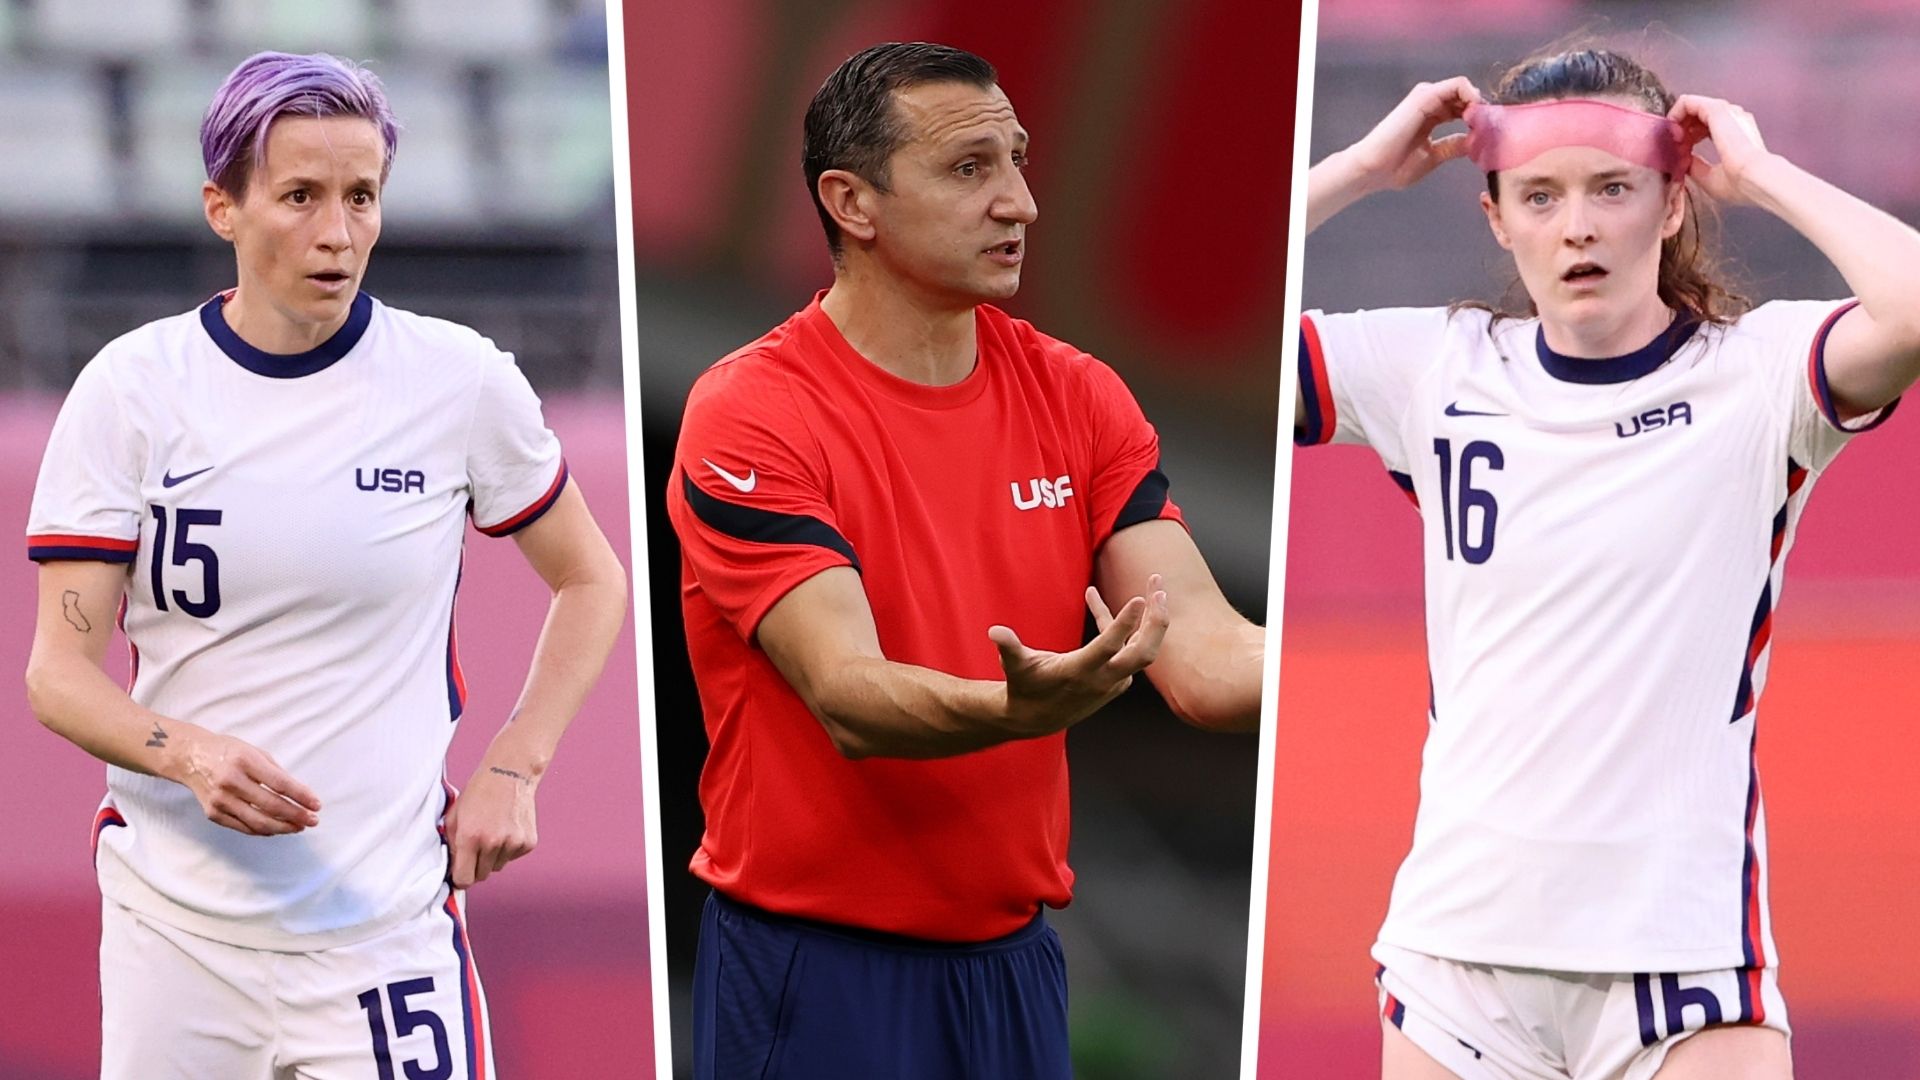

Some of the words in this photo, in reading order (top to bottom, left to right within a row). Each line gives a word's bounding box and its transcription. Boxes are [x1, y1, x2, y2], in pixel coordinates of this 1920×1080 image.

[1615, 401, 1692, 438] USA
[356, 468, 425, 494] USA
[1434, 437, 1504, 564] 16
[150, 504, 222, 618] 15
[357, 976, 452, 1080] 15
